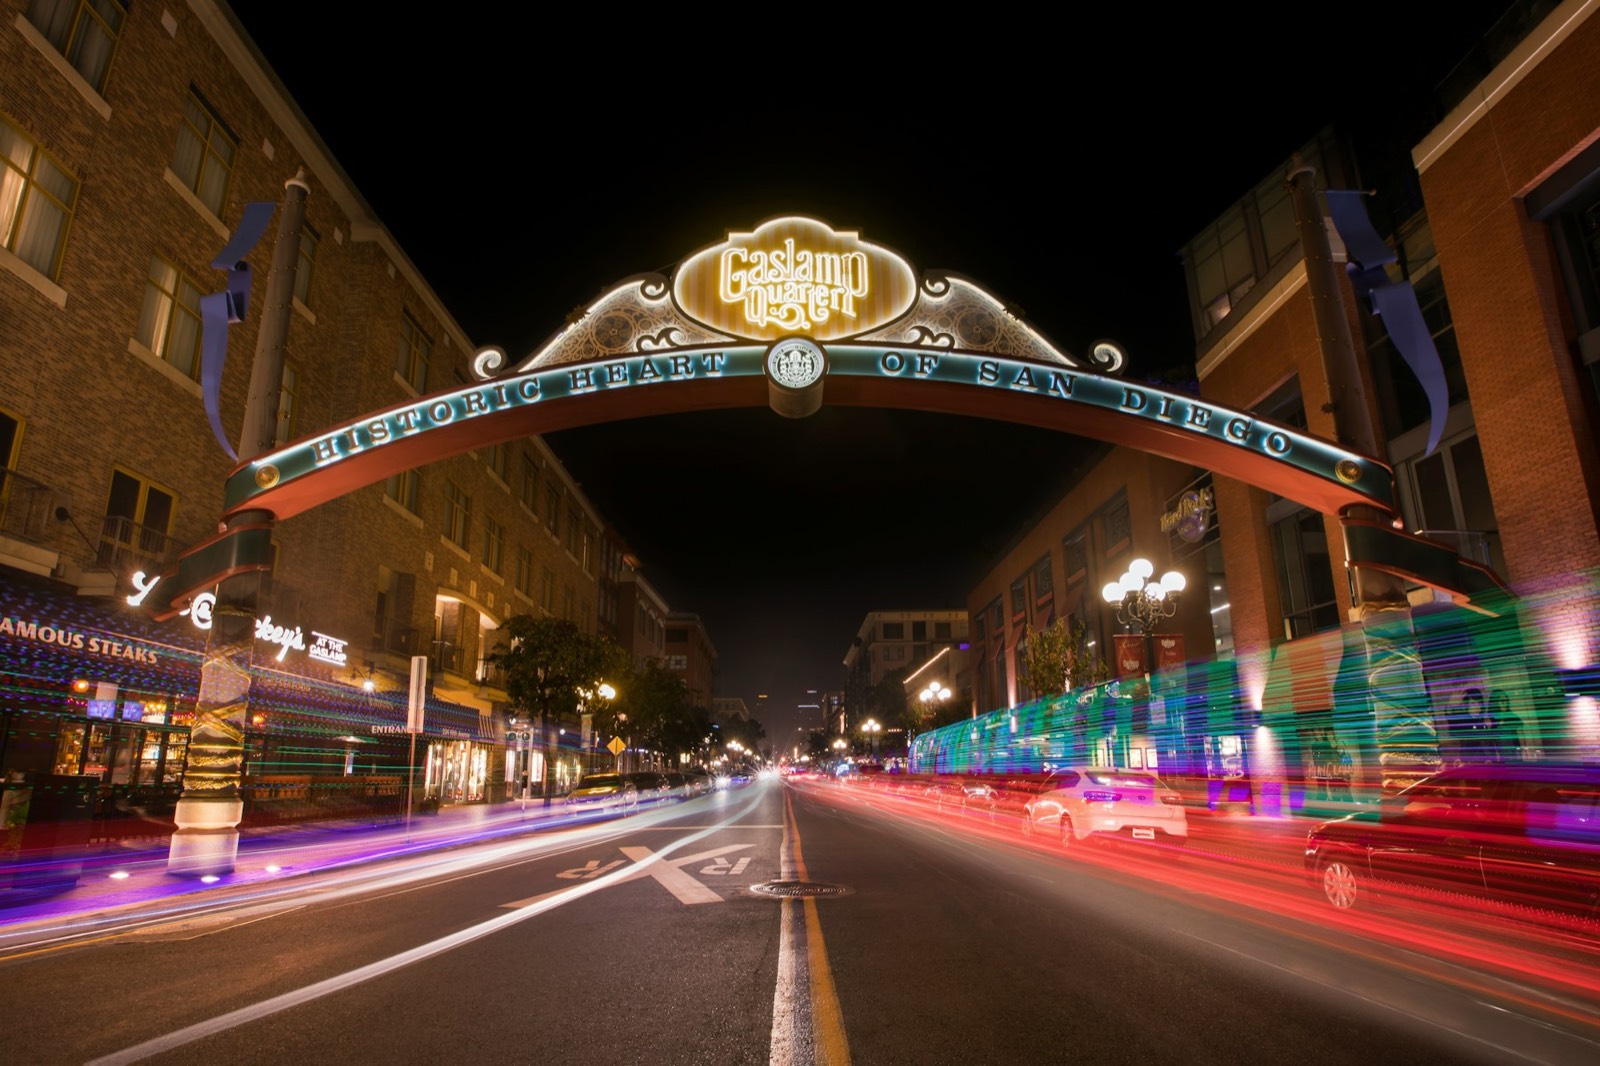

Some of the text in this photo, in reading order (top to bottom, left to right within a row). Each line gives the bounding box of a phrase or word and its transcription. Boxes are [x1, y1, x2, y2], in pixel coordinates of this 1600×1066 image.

[719, 238, 869, 304] Gaslamp
[744, 281, 857, 331] Quarter
[311, 377, 541, 466] HISTORIC
[568, 351, 724, 395] HEART
[880, 350, 939, 378] OF
[978, 360, 1078, 398] SAN
[1120, 386, 1293, 457] DIEGO
[0, 617, 158, 664] AMOUS STEAKS
[309, 644, 347, 663] GASLAMP
[316, 636, 344, 653] AT THE
[371, 725, 407, 734] ENTRAN
